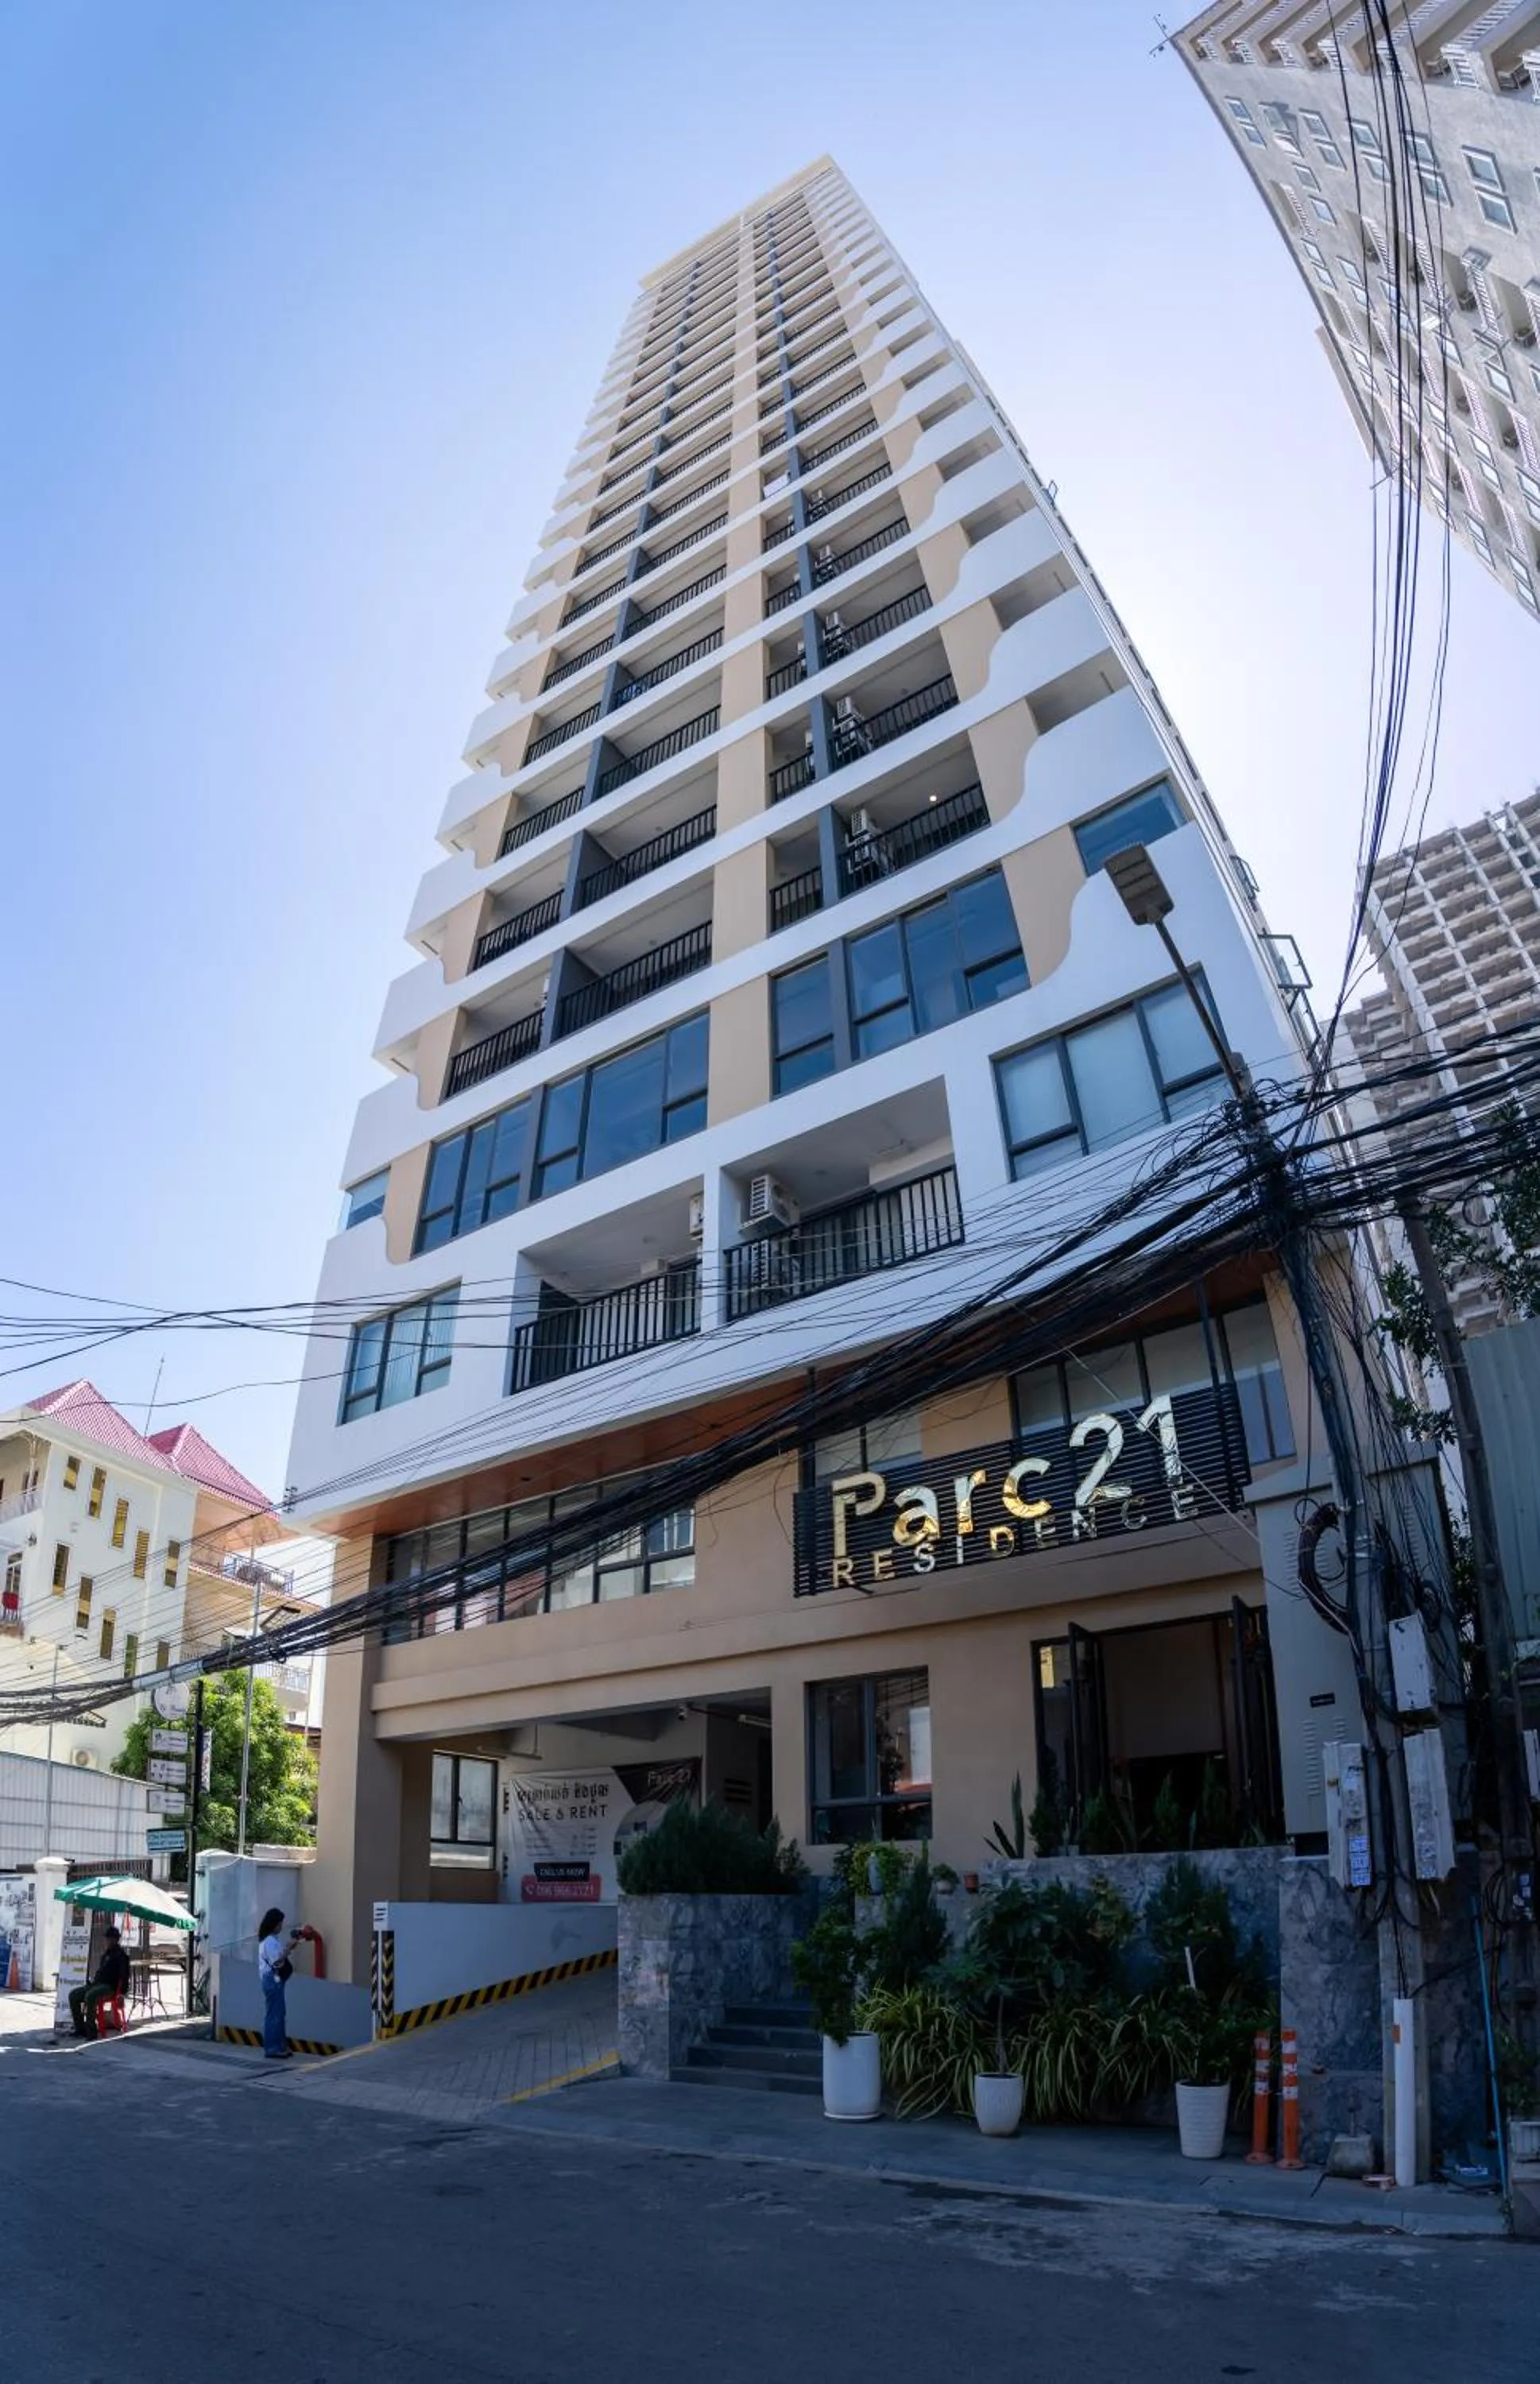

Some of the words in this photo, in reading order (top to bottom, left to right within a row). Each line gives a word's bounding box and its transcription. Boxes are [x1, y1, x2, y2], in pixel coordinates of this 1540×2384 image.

[831, 1483, 1199, 1589] RESIDENCE
[519, 1808, 550, 1821] SALE
[571, 1805, 608, 1819] RENT
